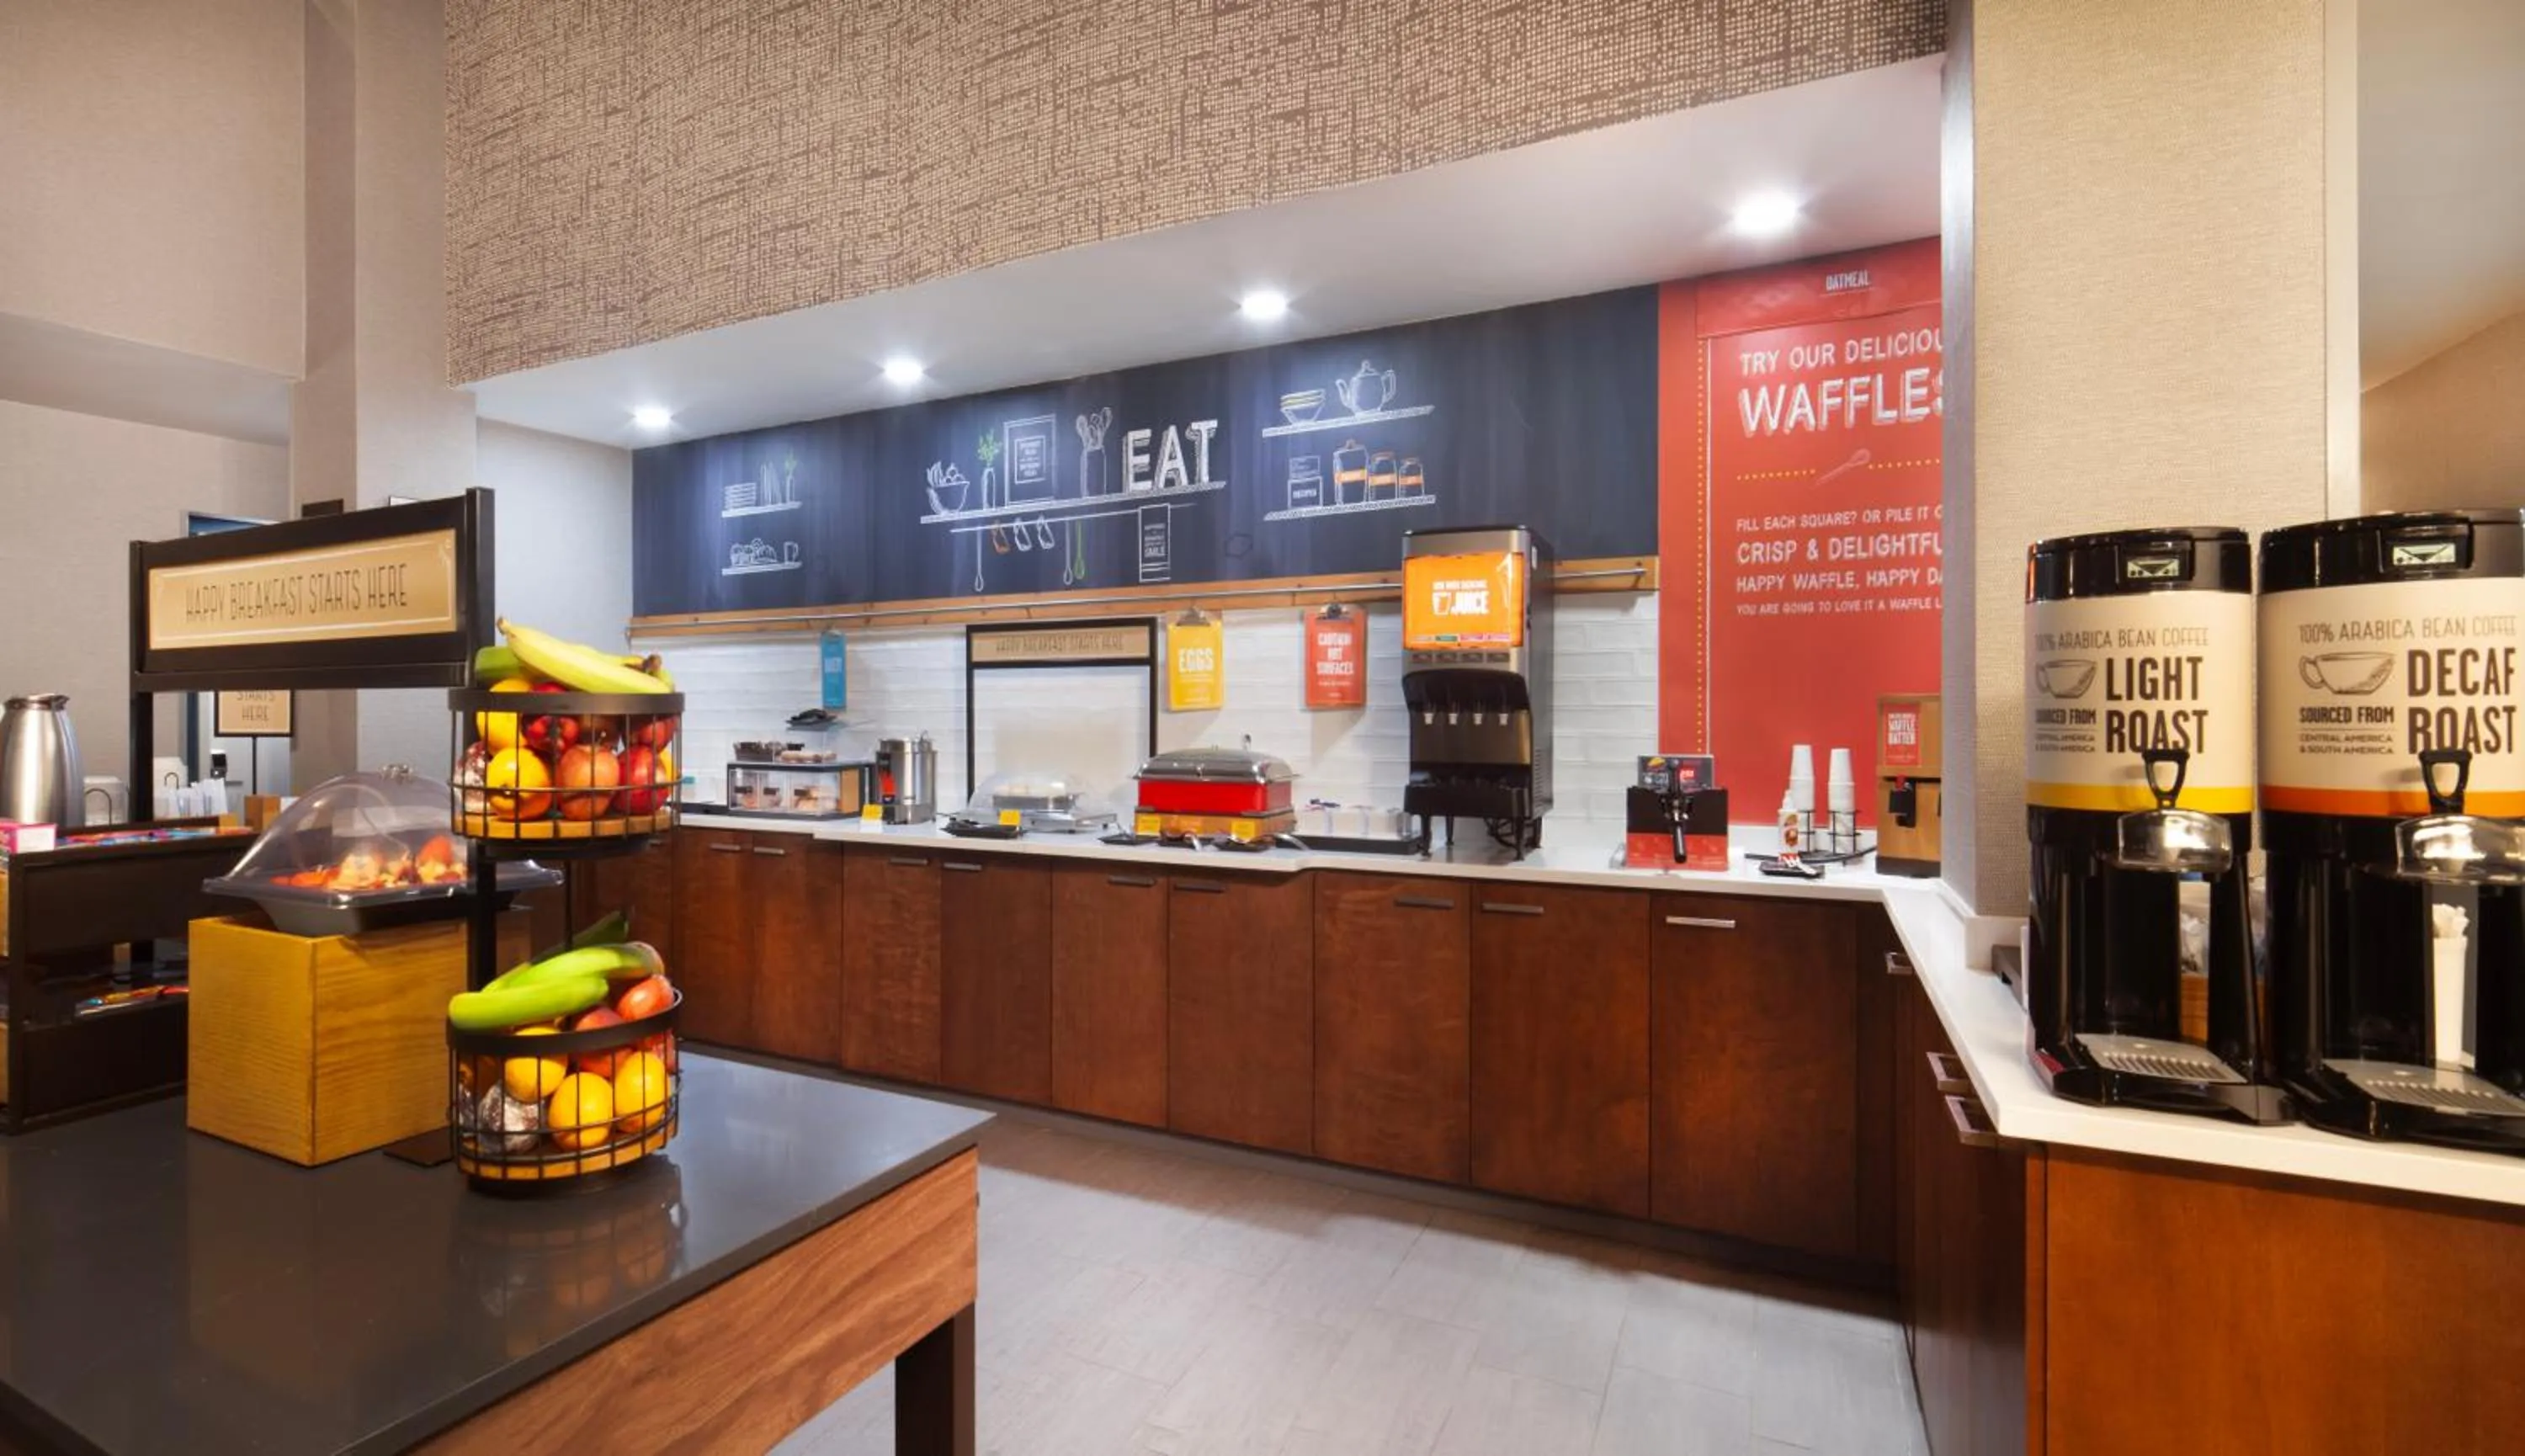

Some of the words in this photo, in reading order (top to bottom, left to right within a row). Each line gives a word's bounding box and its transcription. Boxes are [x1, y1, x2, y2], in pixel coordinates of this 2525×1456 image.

[1826, 270, 1870, 291] OATMEAL
[1741, 349, 1779, 376] TRY
[1789, 343, 1835, 370] OUR
[1123, 419, 1219, 493] EAT
[1736, 518, 1759, 532] FILL
[1764, 515, 1795, 530] EACH
[1801, 511, 1857, 529] SQUARE?
[1863, 509, 1881, 523] OR
[1885, 507, 1912, 523] PILE
[1917, 506, 1929, 520] IT
[1737, 539, 1796, 565] CRISP
[1806, 538, 1819, 561] &
[1736, 575, 1784, 592] HAPPY
[1793, 571, 1859, 590] WAFFLE,
[1866, 567, 1920, 587] HAPPY
[186, 585, 225, 623] HAPPY
[231, 575, 303, 620] BREAKFAST
[309, 569, 361, 614] STARTS
[367, 563, 407, 609] HERE
[1736, 604, 1757, 615] YOU
[1760, 603, 1779, 614] ARE
[1819, 601, 1831, 613] TO
[1835, 600, 1861, 612] LOVE
[1863, 600, 1874, 611] IT
[1889, 597, 1932, 610] WAFFLE
[2059, 630, 2113, 650] ARABICA
[2118, 629, 2156, 648] BEAN
[2162, 627, 2209, 646] COFFEE
[2299, 624, 2335, 644] 100%
[2339, 619, 2415, 641] ARABICA
[2422, 617, 2465, 638] BEAN
[2472, 615, 2517, 636] COFFEE
[1179, 647, 1214, 672] EGGS
[2408, 648, 2517, 697] DECAF
[2106, 656, 2203, 701] LIGHT
[2069, 709, 2096, 725] FROM
[2299, 706, 2352, 724] SOURCED
[2358, 706, 2395, 724] FROM
[2106, 709, 2209, 754] ROAST
[2299, 733, 2341, 743] CENTRAL
[2344, 734, 2393, 743] AMERICA
[2408, 706, 2517, 754] ROAST
[2307, 745, 2341, 754] SOUTH
[2344, 745, 2394, 755] AMERICA
